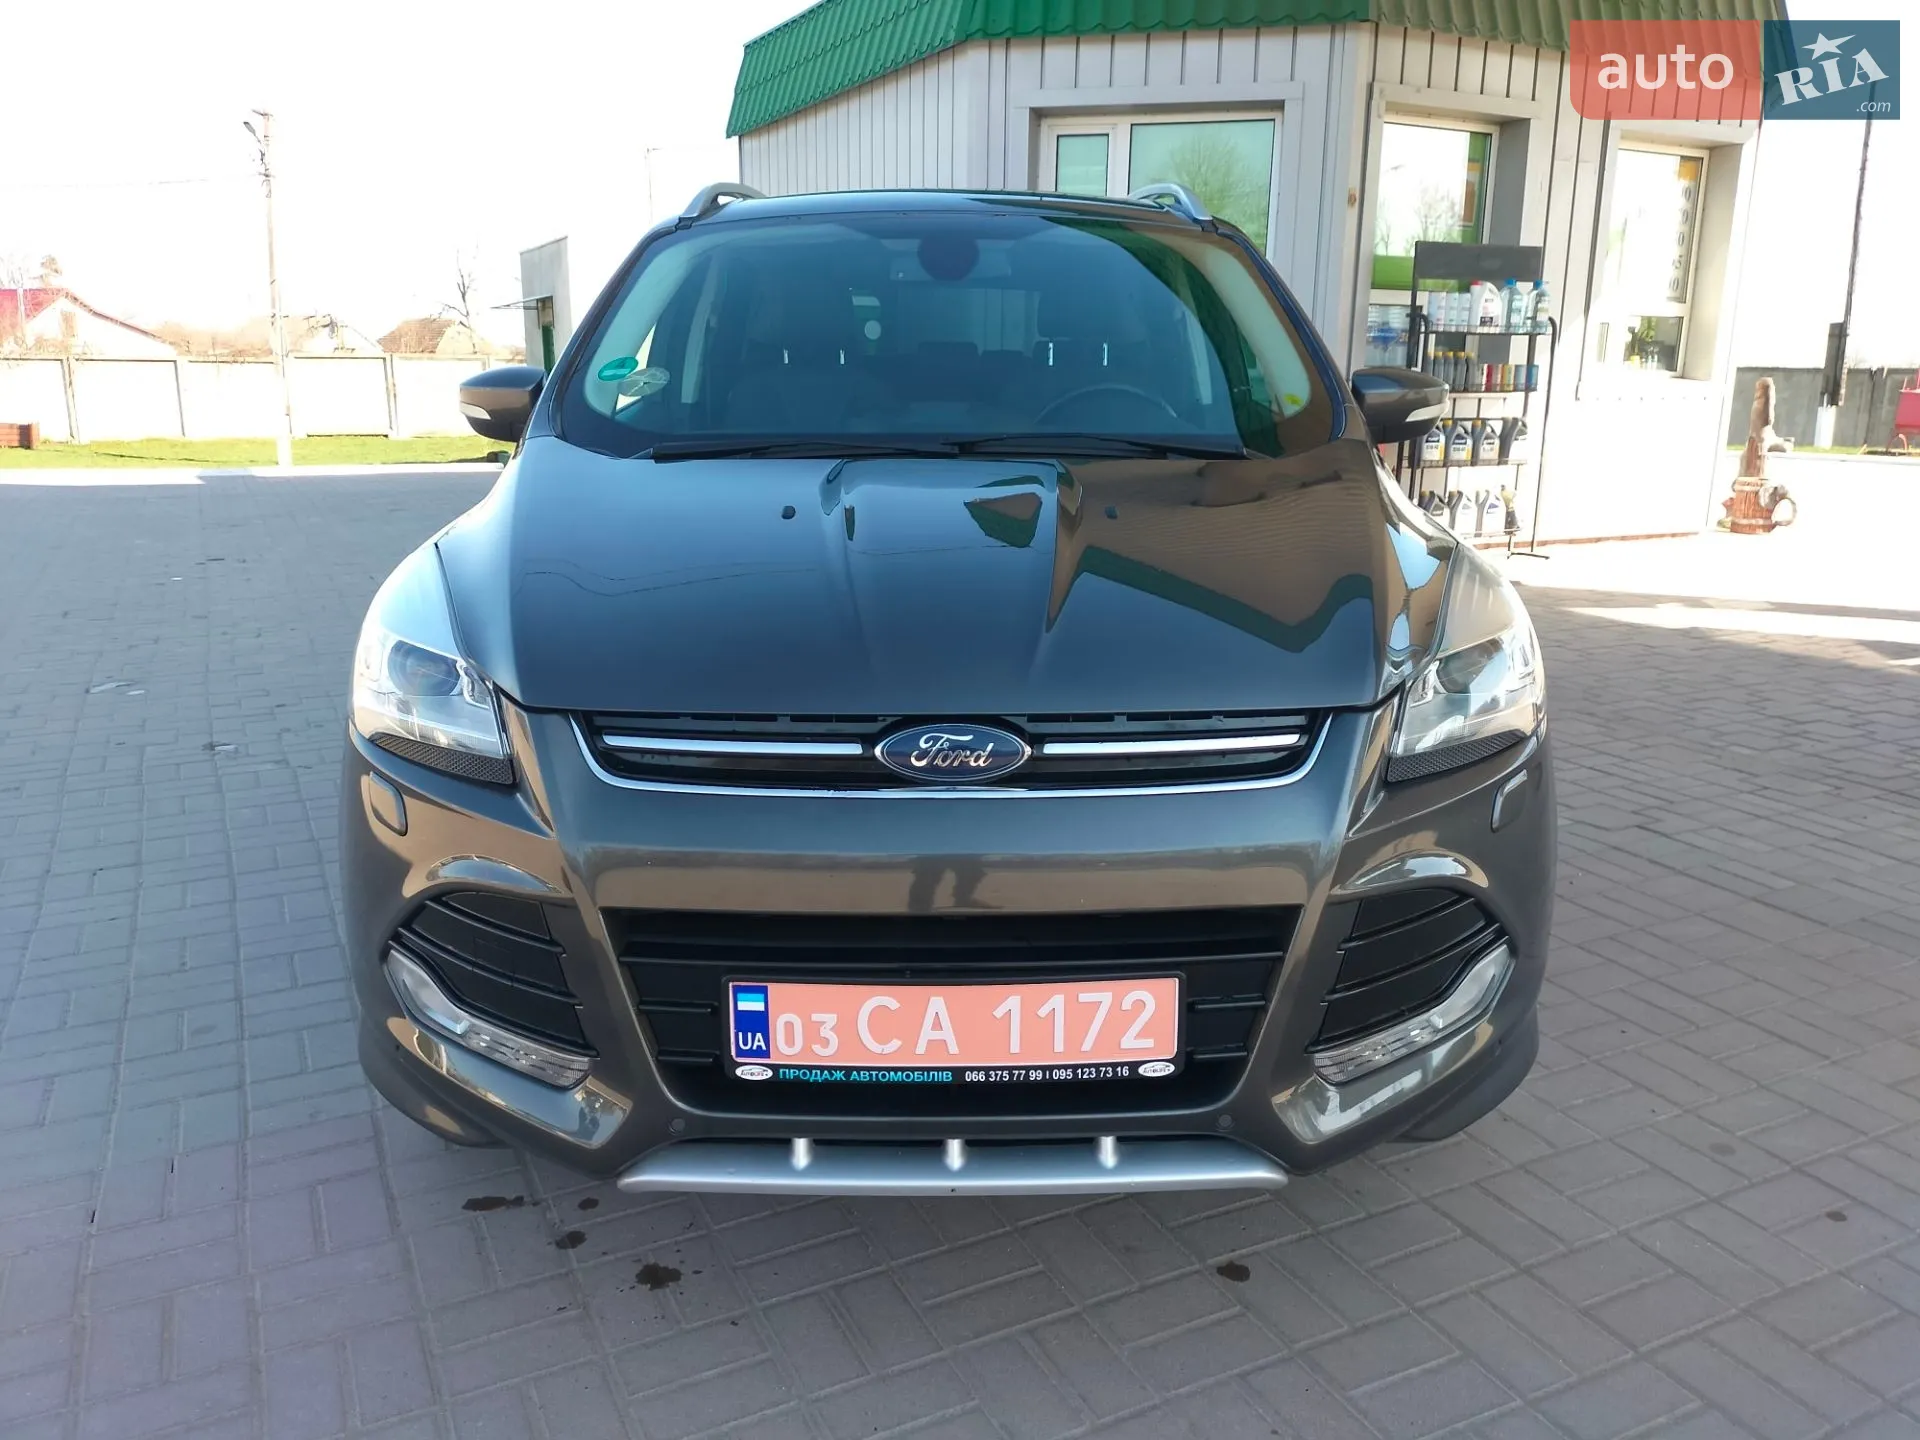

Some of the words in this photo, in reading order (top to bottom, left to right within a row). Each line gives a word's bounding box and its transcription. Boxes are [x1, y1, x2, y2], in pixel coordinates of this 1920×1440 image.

[910, 733, 994, 767] Ford
[776, 1013, 839, 1056] 03
[857, 995, 960, 1055] CA
[992, 990, 1156, 1054] 1172
[738, 1032, 767, 1050] UA
[779, 1069, 845, 1082] ПРОДАЖ
[849, 1070, 953, 1082] АВТОМОБІЛІВ
[965, 1070, 985, 1082] 066
[988, 1070, 1010, 1081] 375
[1012, 1070, 1026, 1081] 77
[1029, 1070, 1043, 1080] 99
[1052, 1069, 1073, 1080] 095
[1076, 1068, 1096, 1079] 123
[1099, 1067, 1113, 1078] 73
[1116, 1066, 1130, 1077] 16
